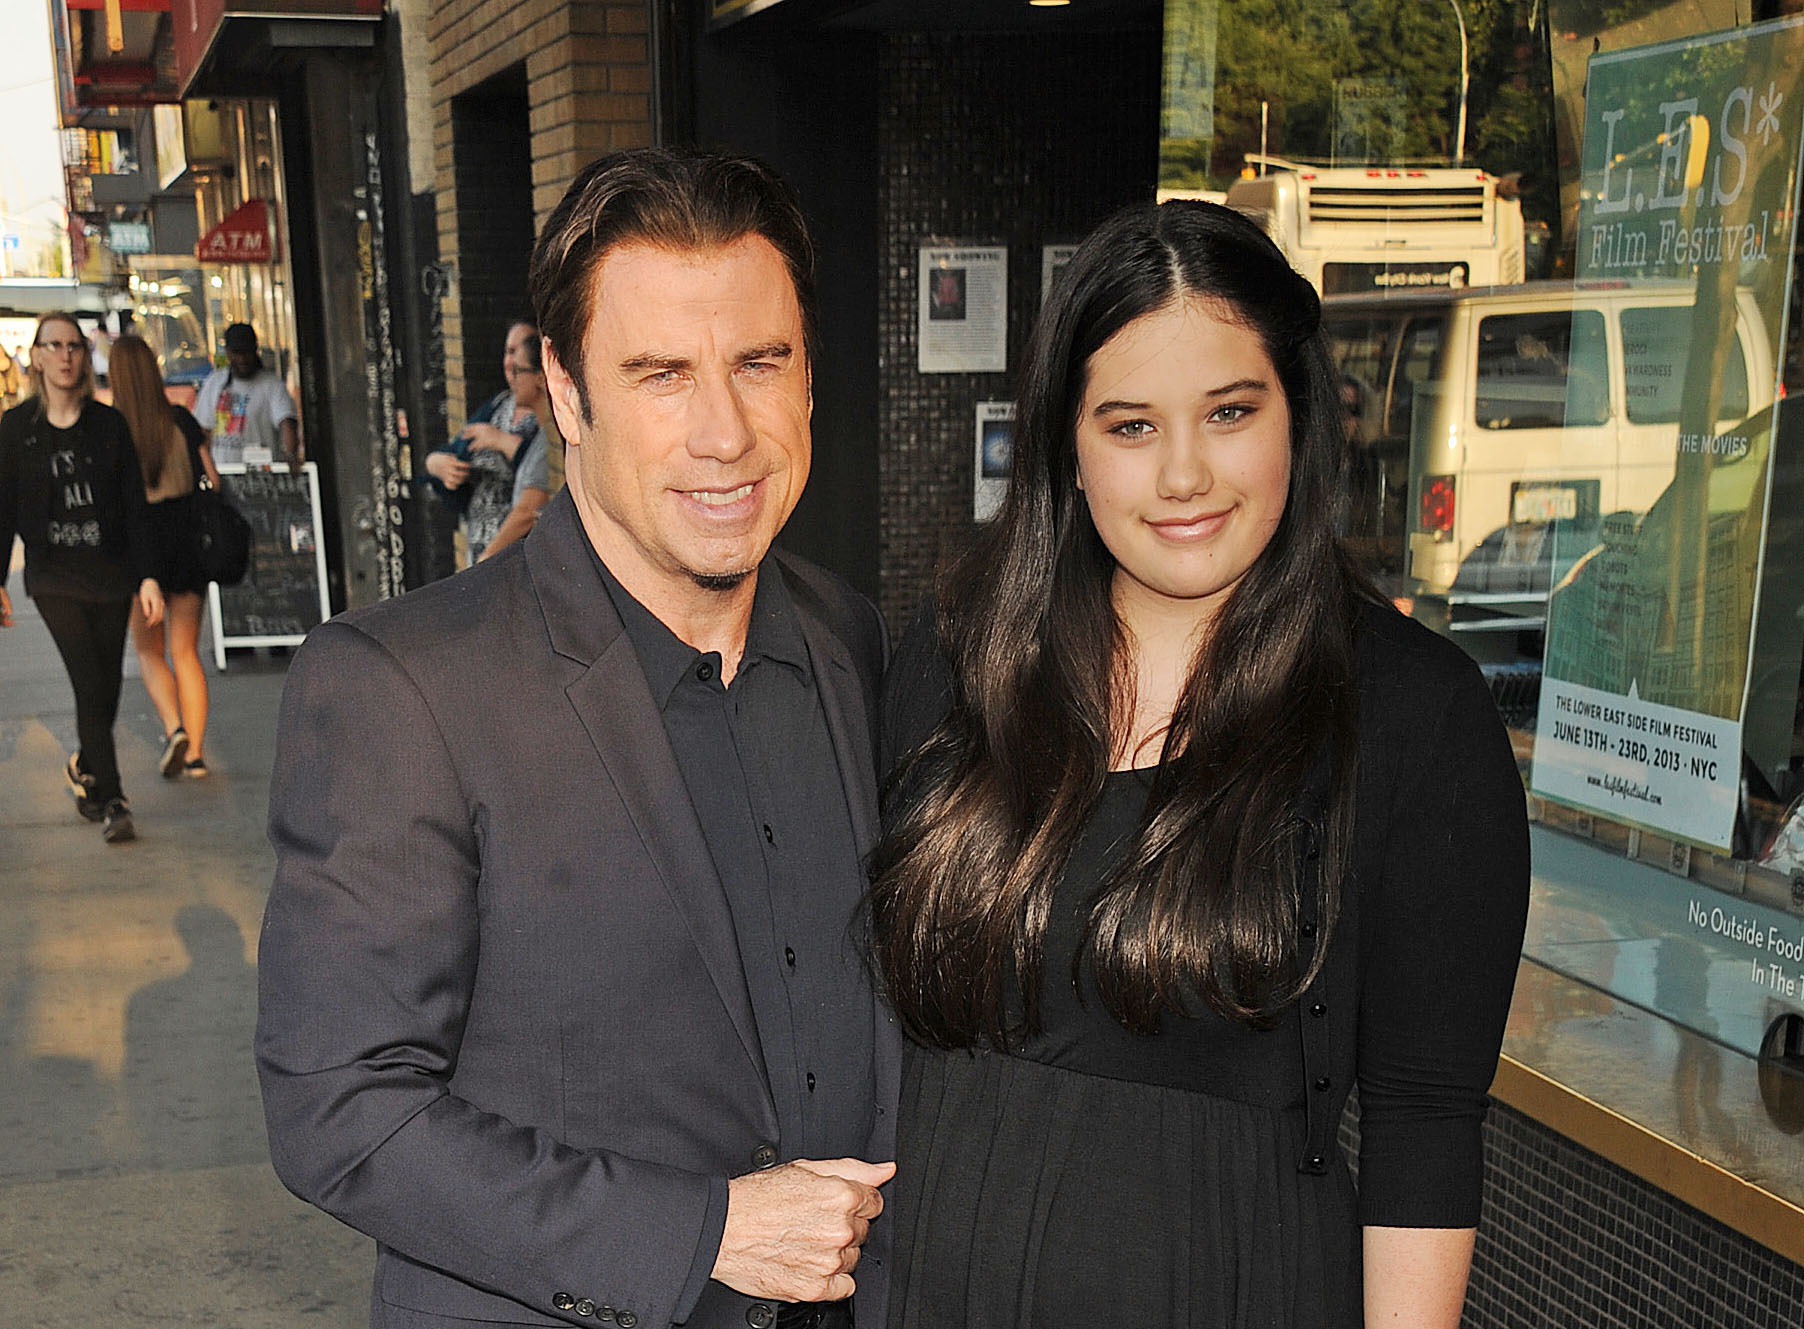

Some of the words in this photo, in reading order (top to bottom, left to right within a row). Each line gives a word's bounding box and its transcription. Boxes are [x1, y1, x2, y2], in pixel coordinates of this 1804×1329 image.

[210, 232, 262, 249] ATM
[1588, 224, 1648, 268] Film
[1655, 210, 1769, 265] Festival
[1701, 435, 1747, 456] MOVIES
[1556, 695, 1571, 712] THE
[1573, 700, 1601, 720] LOWER
[1603, 708, 1625, 725] EAST
[1627, 714, 1648, 732] SIDE
[1650, 719, 1671, 738] FILM
[1673, 725, 1718, 749] FESTIVAL
[1553, 721, 1580, 745] JUNE
[1583, 728, 1608, 752] 13TH
[1618, 738, 1650, 767] 23RD,
[1653, 748, 1680, 772] 2013
[1690, 757, 1718, 781] NYC
[1688, 899, 1707, 927] No
[1710, 907, 1763, 948] Outside
[1767, 926, 1804, 962] Food
[1751, 957, 1764, 984] In
[1769, 963, 1795, 996] The
